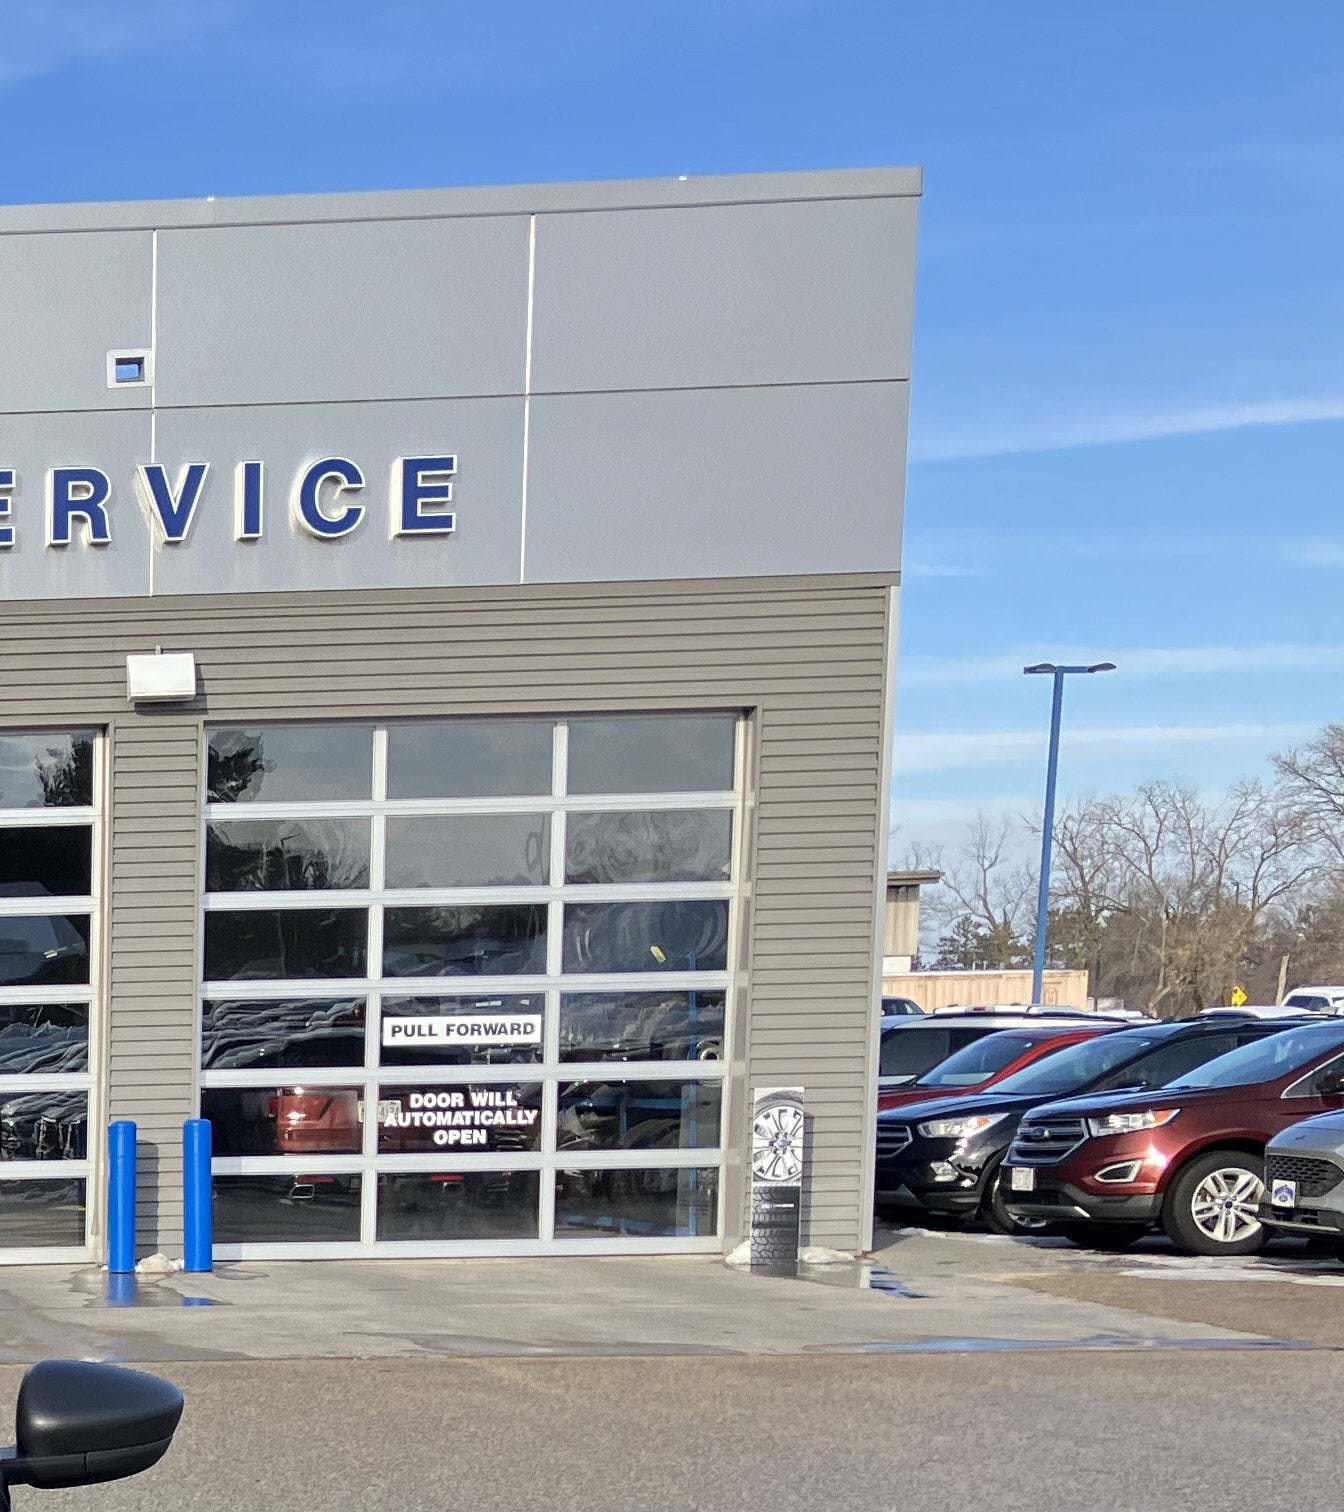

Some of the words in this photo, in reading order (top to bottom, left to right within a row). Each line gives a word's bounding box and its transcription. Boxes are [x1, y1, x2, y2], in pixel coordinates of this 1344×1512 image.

[391, 1024, 438, 1038] PULL
[446, 1022, 535, 1037] FORWARD
[410, 1093, 464, 1108] DOOR
[471, 1091, 517, 1106] WILL
[384, 1109, 538, 1127] AUTOMATICALLY
[434, 1129, 487, 1145] OPEN
